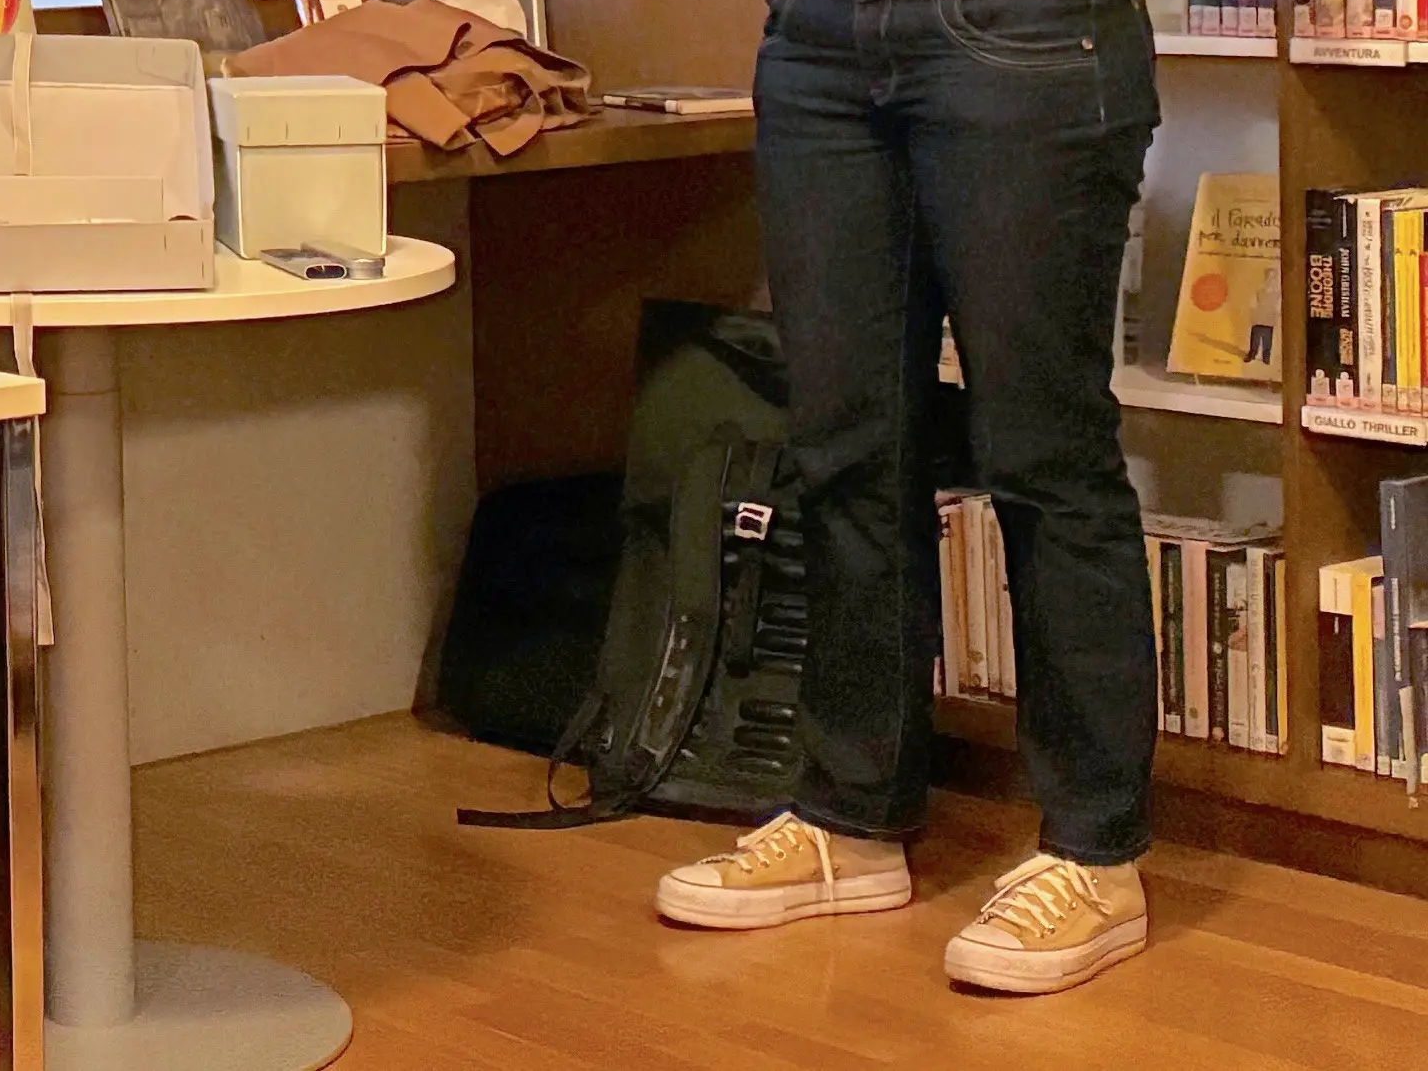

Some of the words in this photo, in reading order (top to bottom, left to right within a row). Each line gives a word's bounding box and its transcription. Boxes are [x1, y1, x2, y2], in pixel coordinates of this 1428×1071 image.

[1314, 42, 1381, 60] AVVENTURA
[1340, 247, 1350, 272] JOHN
[1309, 254, 1323, 319] BOONE
[1322, 255, 1334, 319] THEODORE
[1314, 414, 1356, 430] GIALLO
[1361, 419, 1419, 437] THRILLER
